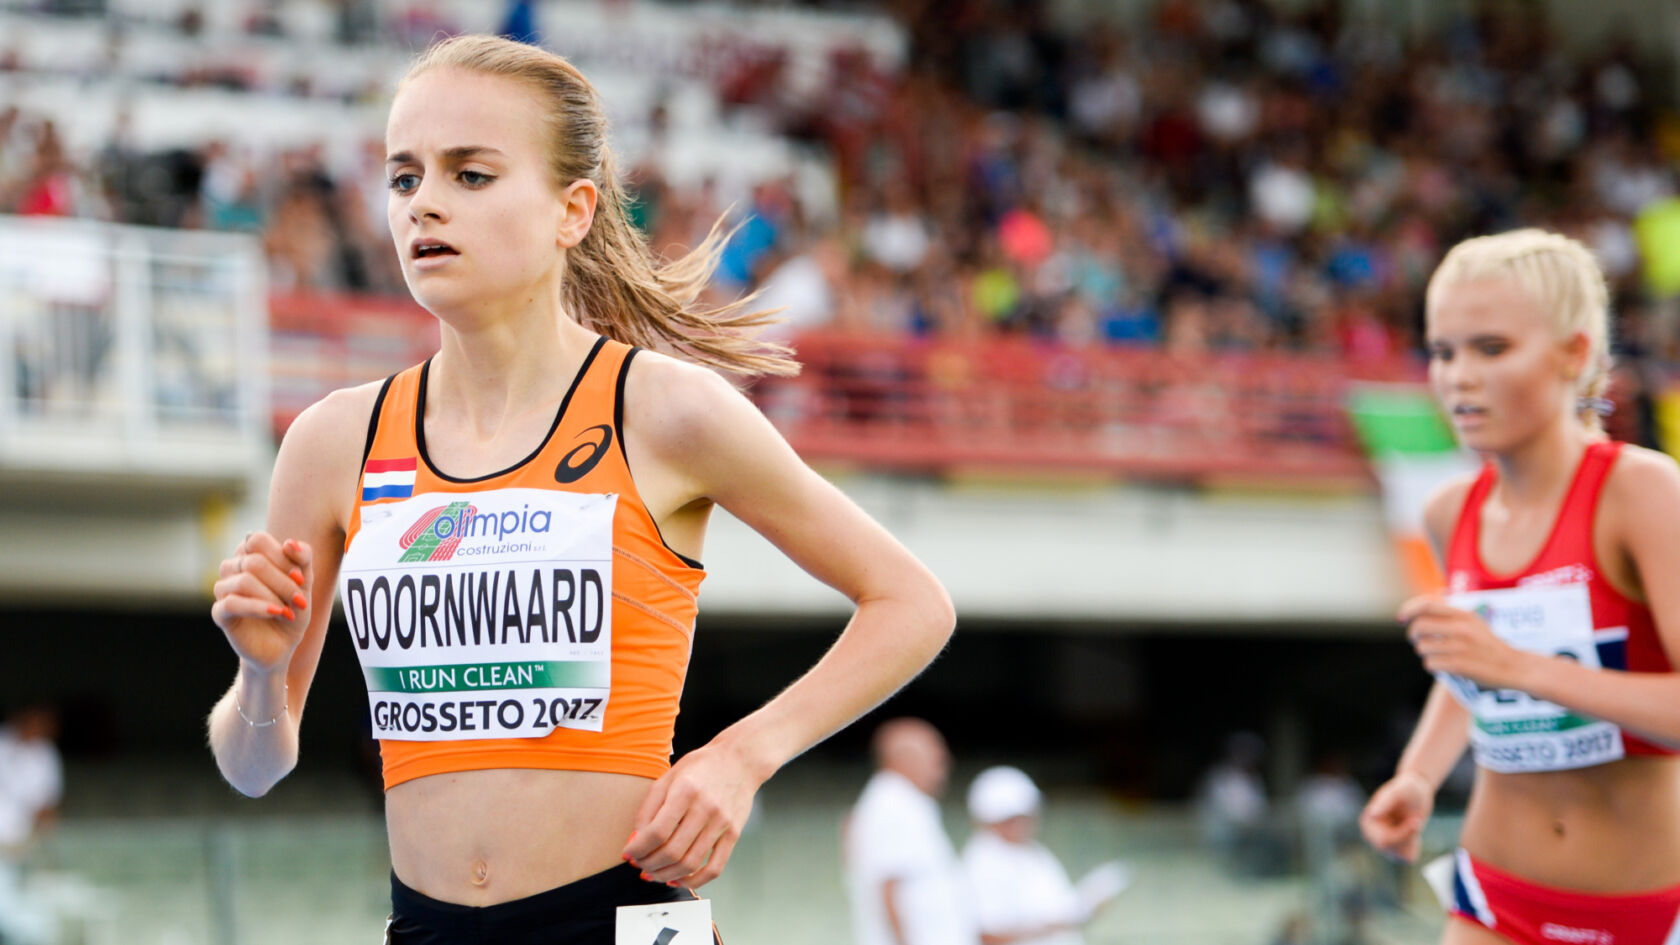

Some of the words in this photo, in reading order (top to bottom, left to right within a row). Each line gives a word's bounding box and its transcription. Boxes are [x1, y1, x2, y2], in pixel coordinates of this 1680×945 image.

[434, 504, 552, 541] olimpia
[456, 541, 532, 556] costruzioni
[347, 569, 604, 650] DOORNWAARD
[399, 670, 406, 689] I
[410, 668, 457, 689] RUN
[374, 699, 524, 732] GROSSETO
[1563, 732, 1613, 757] 2017
